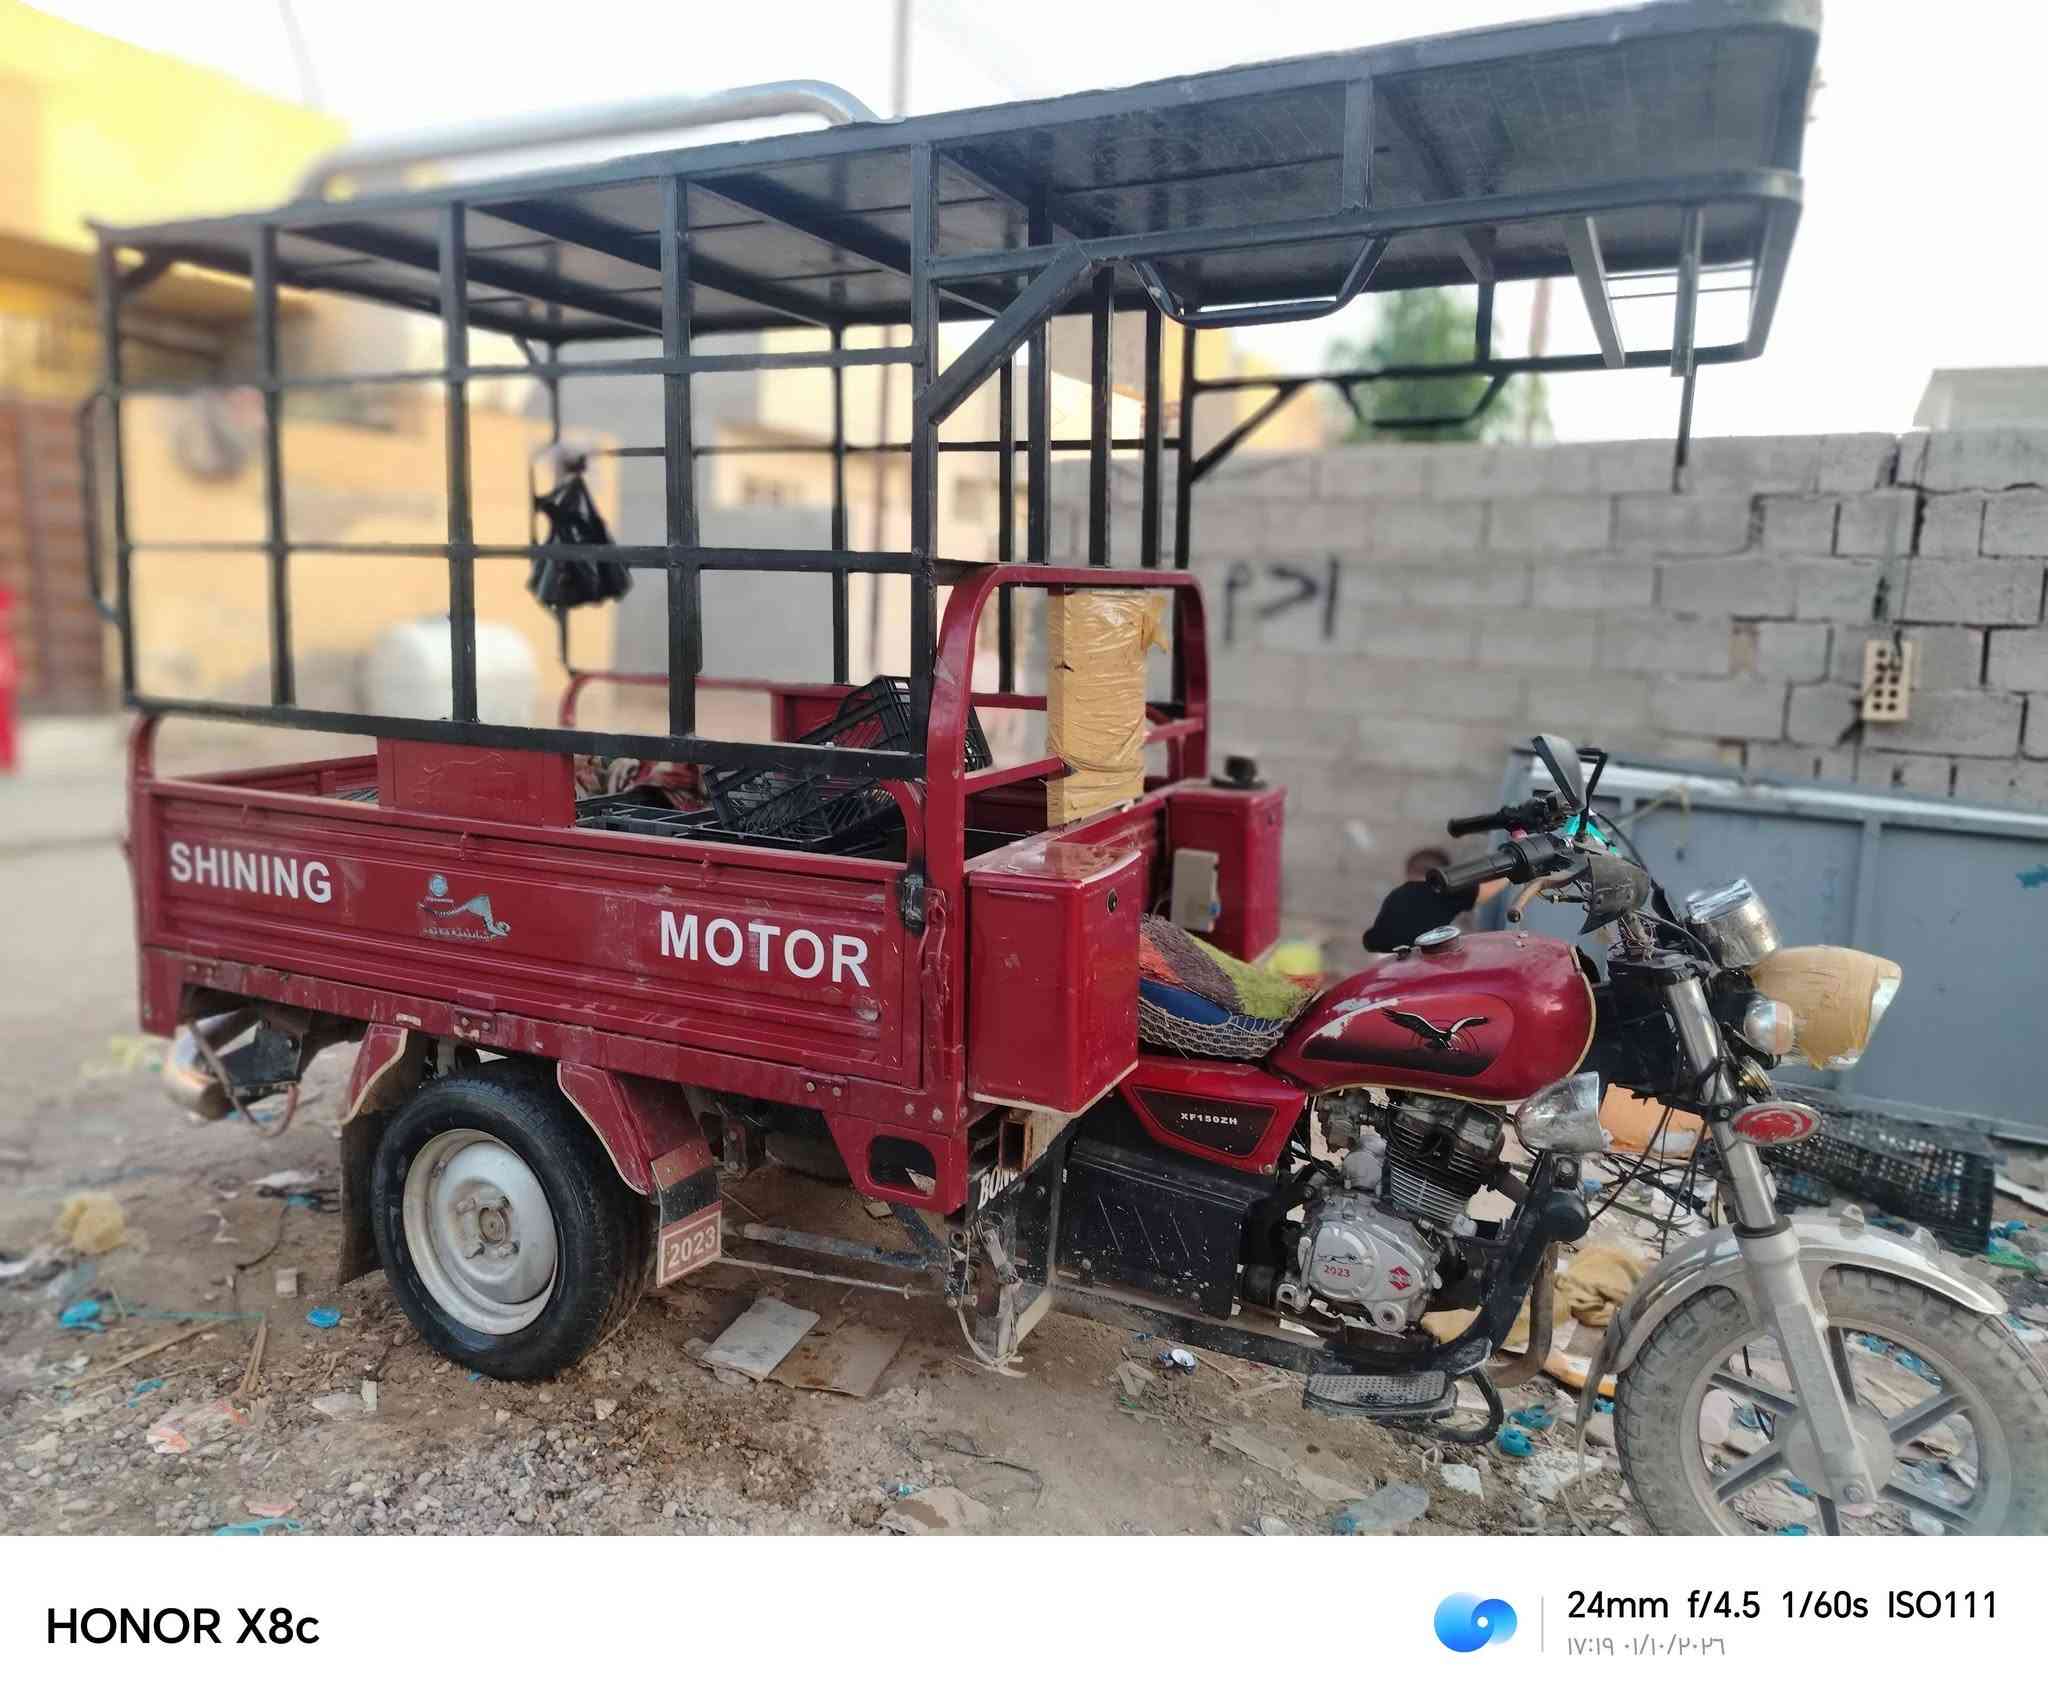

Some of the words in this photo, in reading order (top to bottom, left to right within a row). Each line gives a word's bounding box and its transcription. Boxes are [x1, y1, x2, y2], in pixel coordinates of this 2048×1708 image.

[170, 841, 332, 904] SHINING
[660, 910, 870, 987] MOTOR
[668, 1225, 716, 1269] 2023
[1323, 1264, 1351, 1278] 2023
